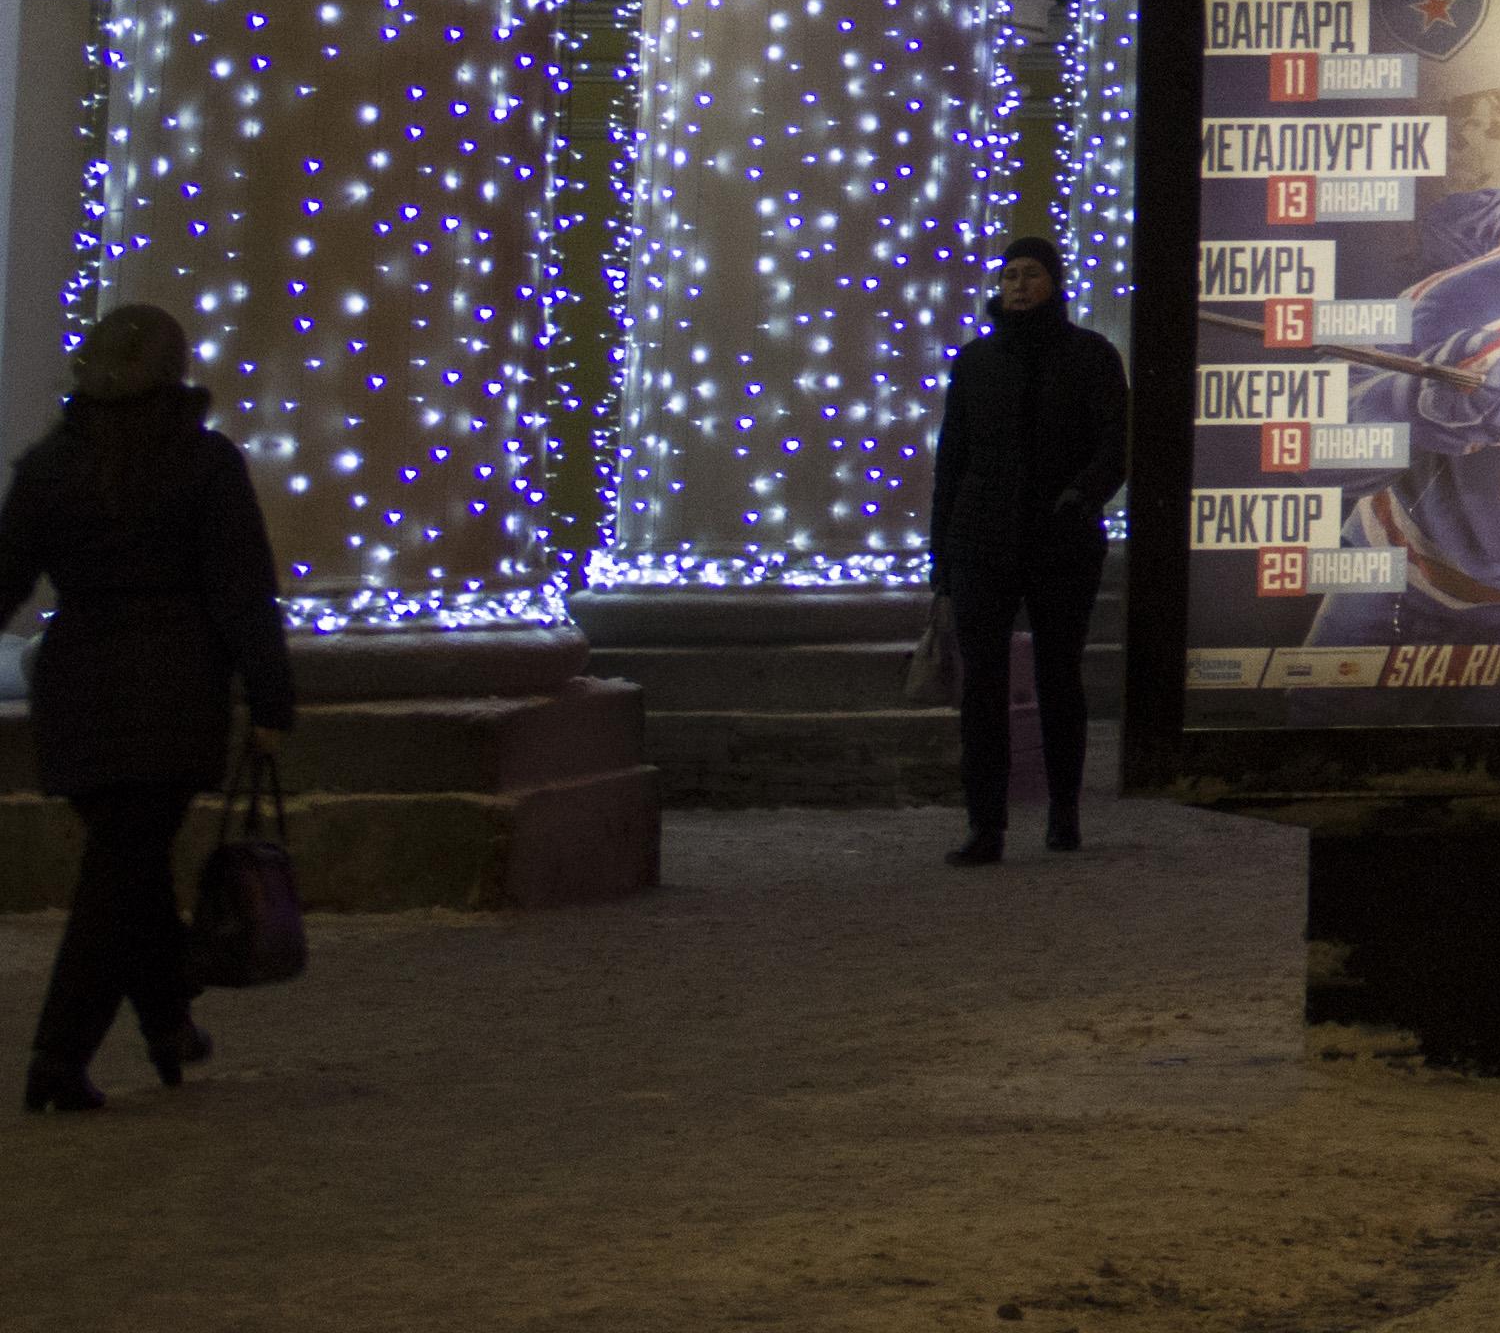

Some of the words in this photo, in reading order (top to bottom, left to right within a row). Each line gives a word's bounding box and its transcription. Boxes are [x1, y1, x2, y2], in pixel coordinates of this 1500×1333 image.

[1204, 0, 1355, 54] ВАНГАРД
[1283, 58, 1306, 96] 11
[1322, 58, 1402, 90] ЯНВАРЯ
[1391, 122, 1431, 171] НК
[1277, 181, 1308, 218] 13
[1320, 180, 1399, 213] ЯНВАРЯ
[1198, 246, 1315, 296] ИБИРЬ
[1274, 304, 1305, 342] 15
[1318, 303, 1397, 336] ЯНВАРЯ
[1196, 369, 1330, 419] ОКЕРИТ
[1271, 427, 1302, 466] 19
[1314, 427, 1395, 460] ЯНВАРЯ
[1262, 552, 1303, 591] 29
[1311, 551, 1392, 584] ЯНВАРЯ
